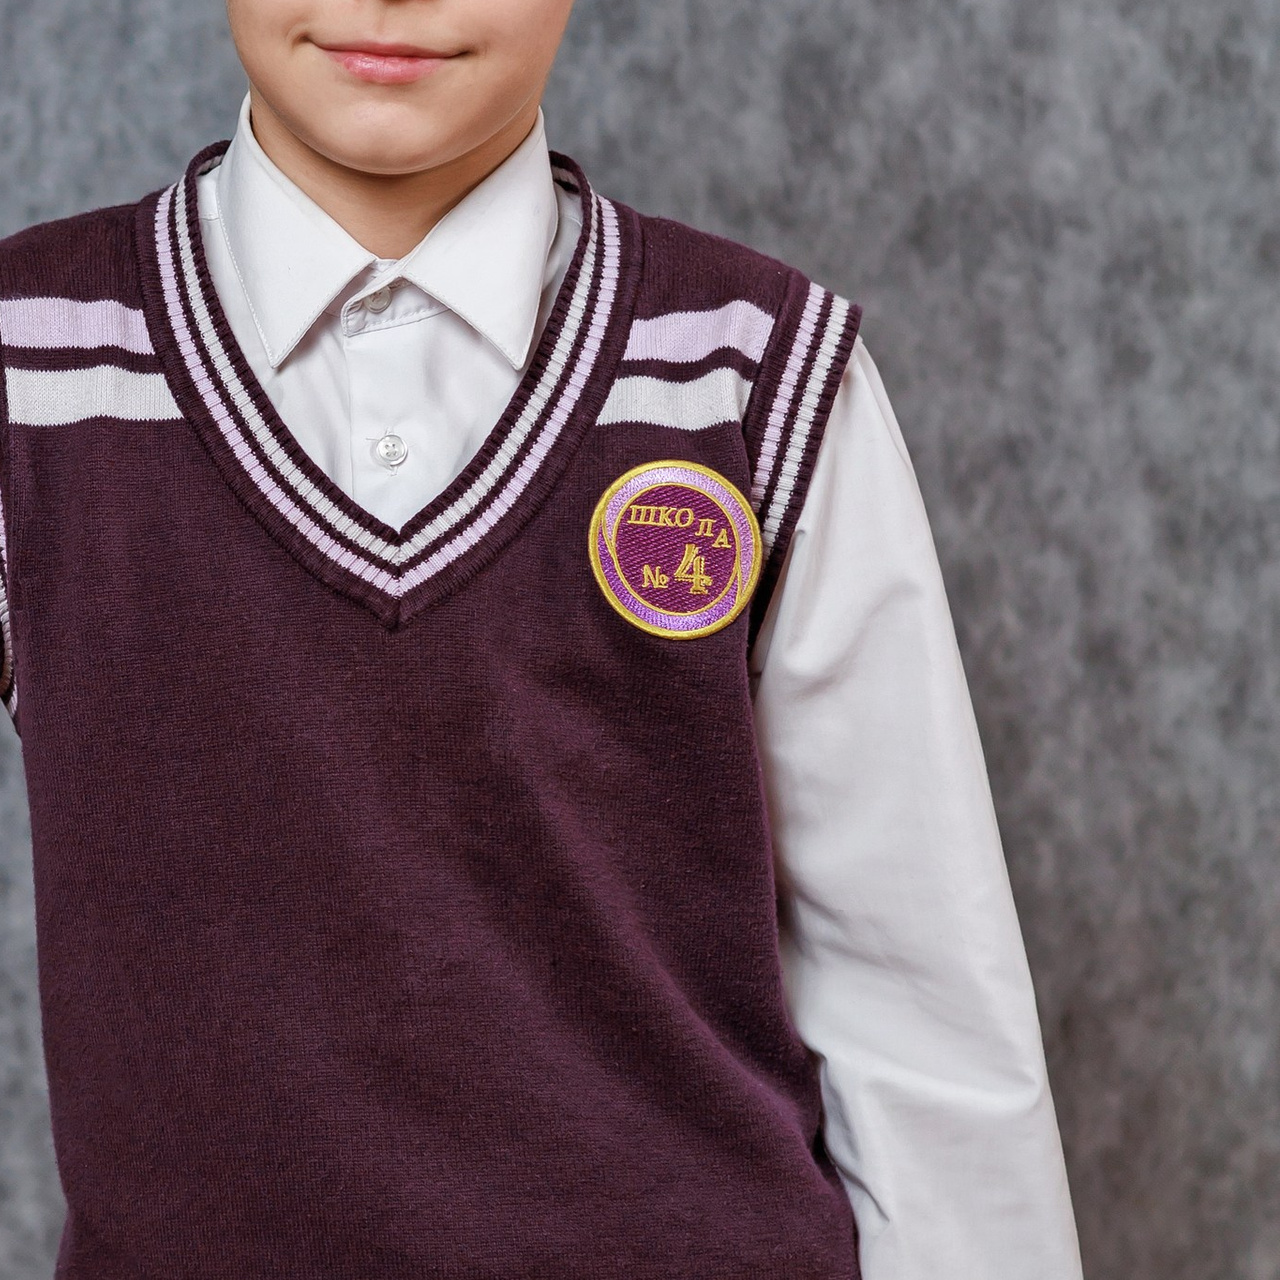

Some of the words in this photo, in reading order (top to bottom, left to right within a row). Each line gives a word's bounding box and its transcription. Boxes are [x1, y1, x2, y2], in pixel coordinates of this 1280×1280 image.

[627, 505, 731, 548] ШКОЛА
[642, 564, 669, 588] №
[674, 543, 713, 594] 4
